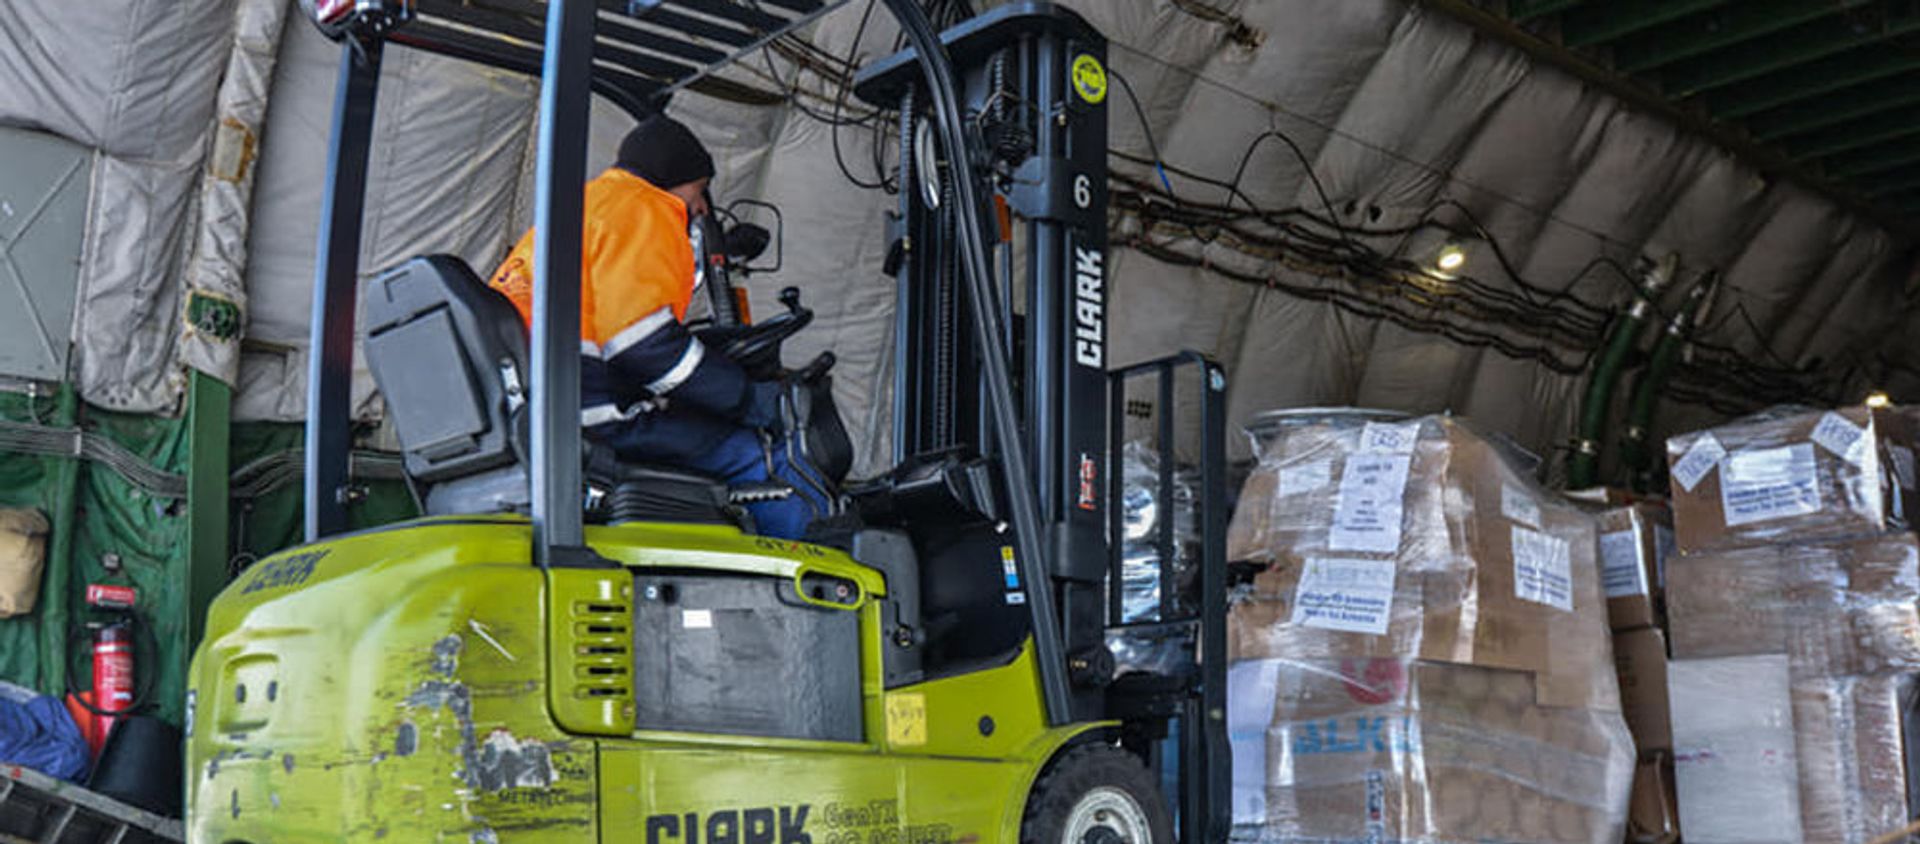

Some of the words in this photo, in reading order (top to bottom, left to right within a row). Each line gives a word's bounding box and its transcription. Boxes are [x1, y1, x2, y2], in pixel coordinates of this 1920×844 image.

[1074, 175, 1091, 208] 6
[1077, 248, 1102, 368] CLARK
[646, 803, 813, 844] CLARK
